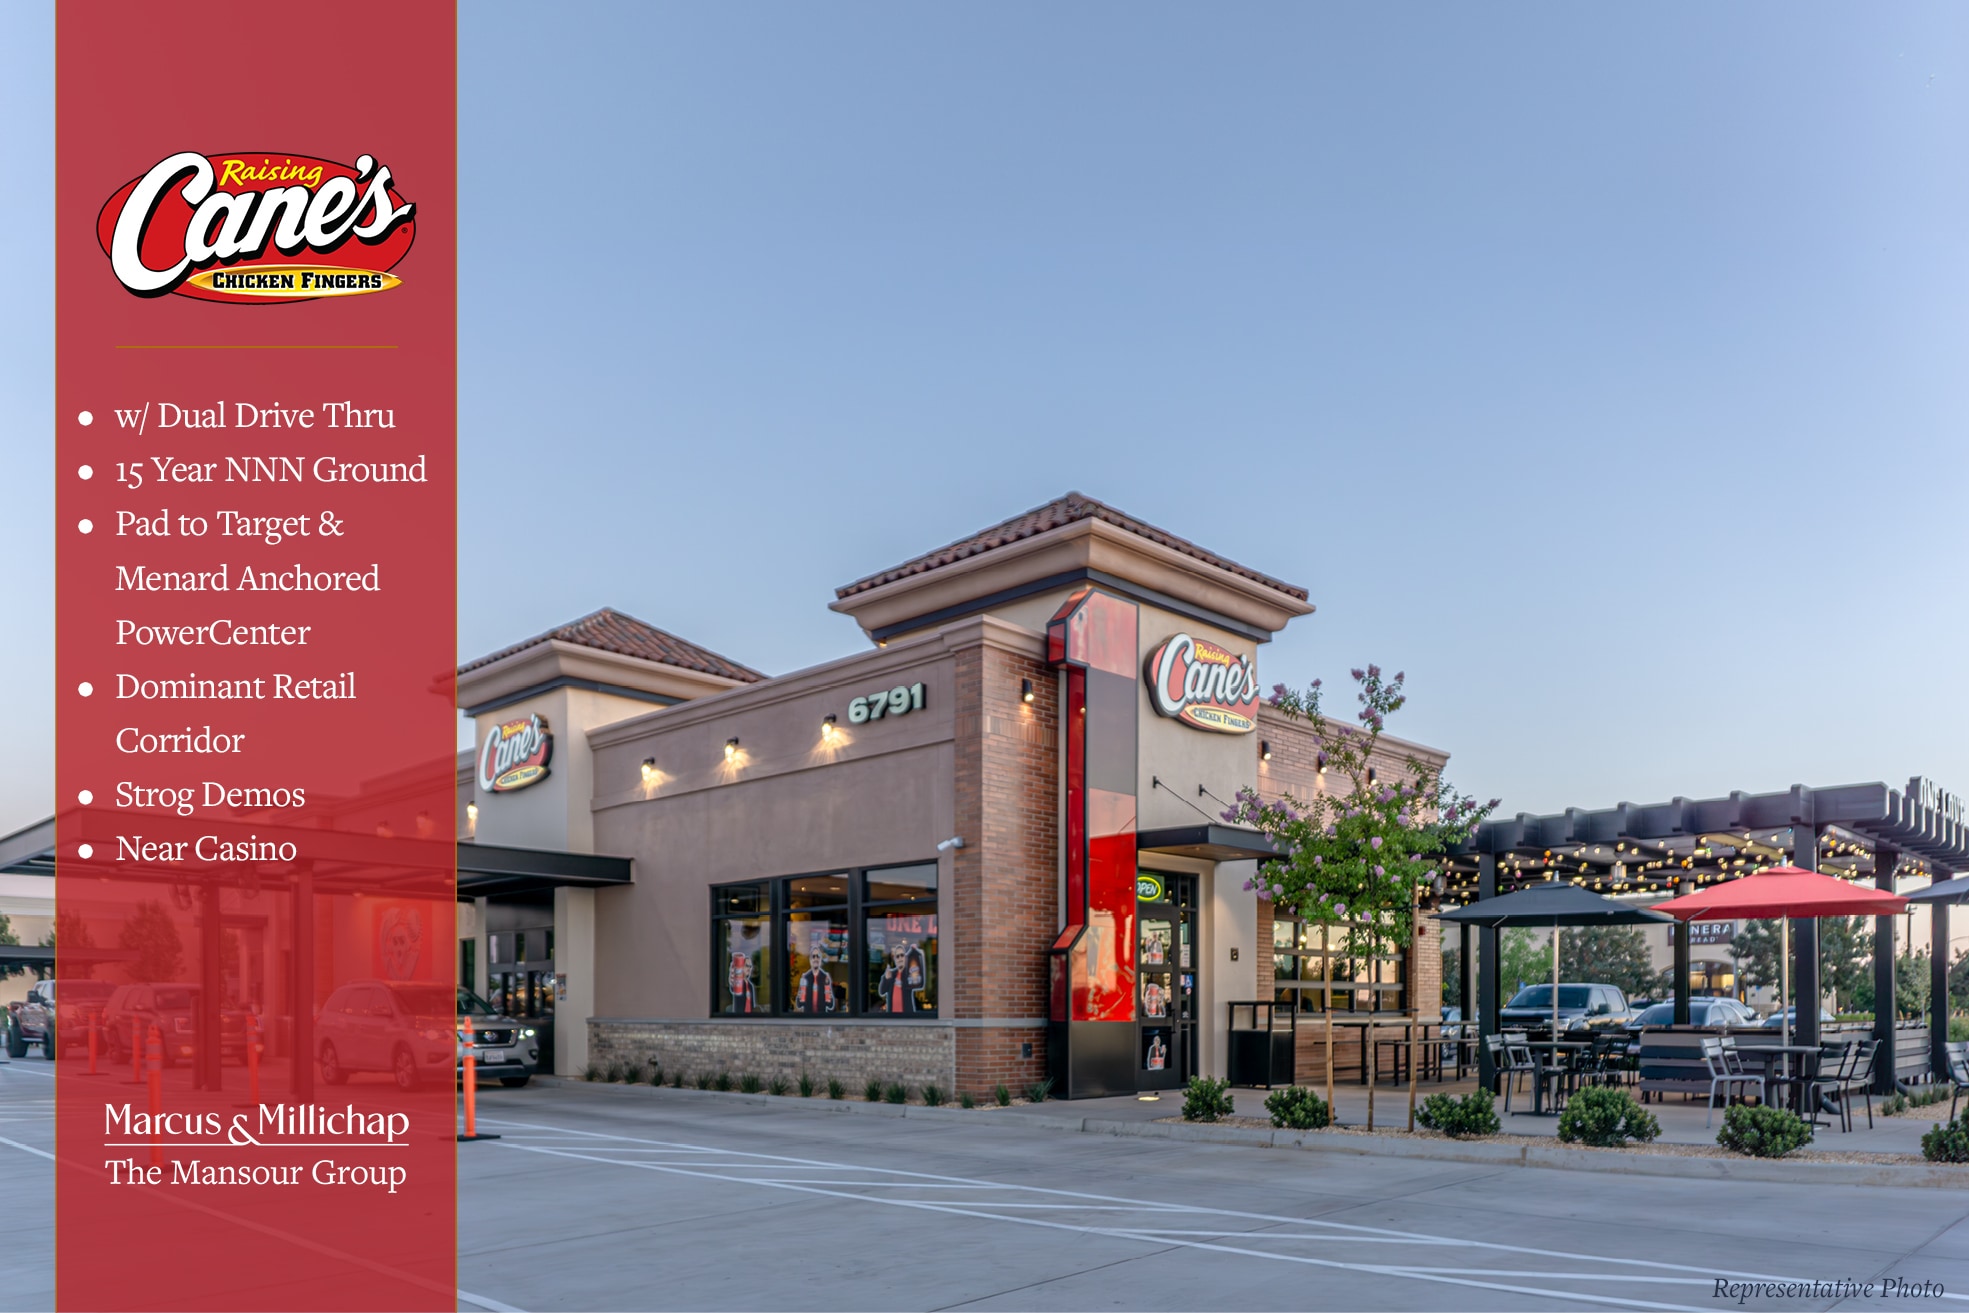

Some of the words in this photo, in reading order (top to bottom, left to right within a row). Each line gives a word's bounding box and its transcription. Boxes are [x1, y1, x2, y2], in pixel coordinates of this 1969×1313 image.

[1157, 632, 1260, 716] Cane's
[1195, 643, 1230, 667] Raising
[848, 682, 926, 724] 6791
